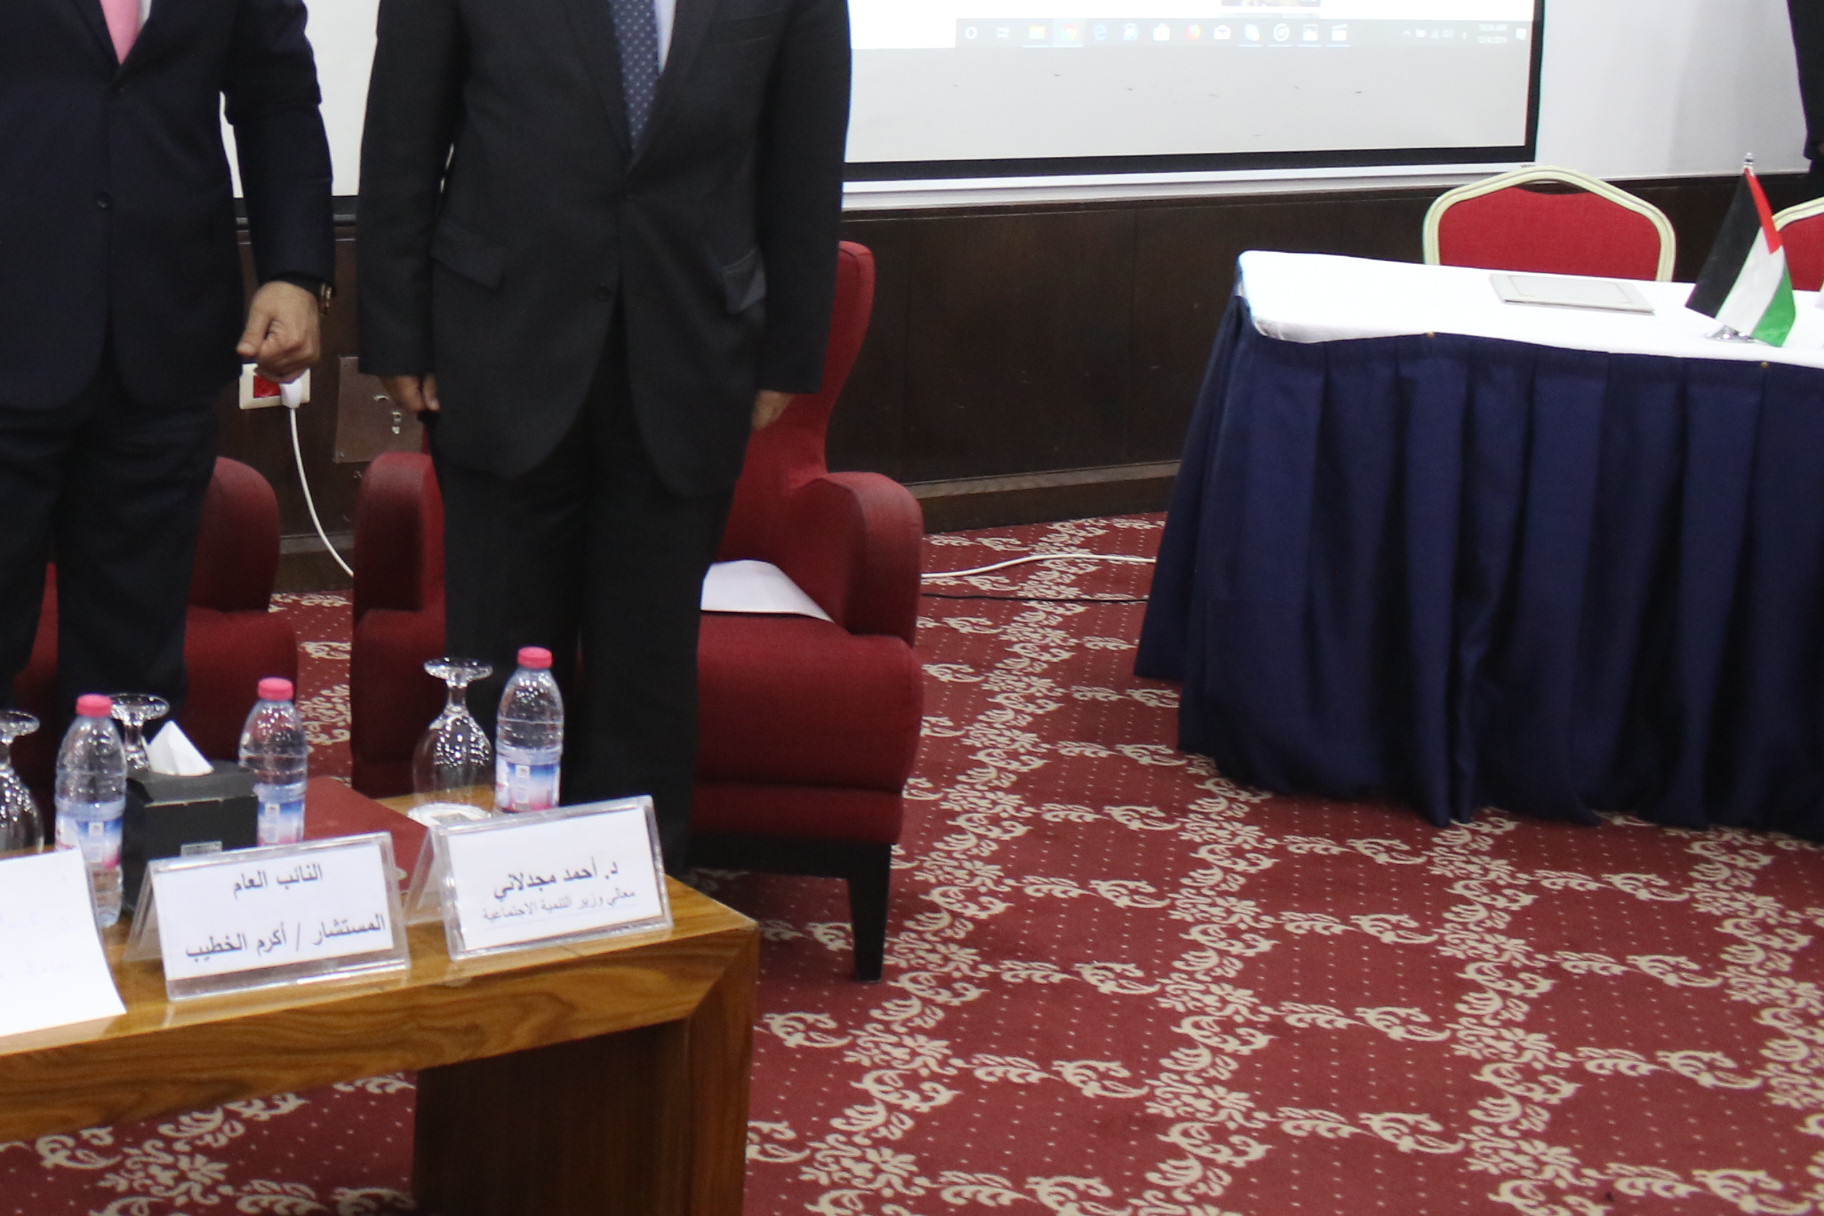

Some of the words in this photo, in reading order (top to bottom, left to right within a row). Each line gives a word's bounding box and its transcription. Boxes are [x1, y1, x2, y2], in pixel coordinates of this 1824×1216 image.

[276, 863, 324, 890] النائب
[562, 855, 598, 882] أحمد
[232, 871, 268, 900] العام
[255, 920, 287, 957] أكرم
[311, 913, 387, 946] المستشار
[185, 933, 248, 963] الخطيب
